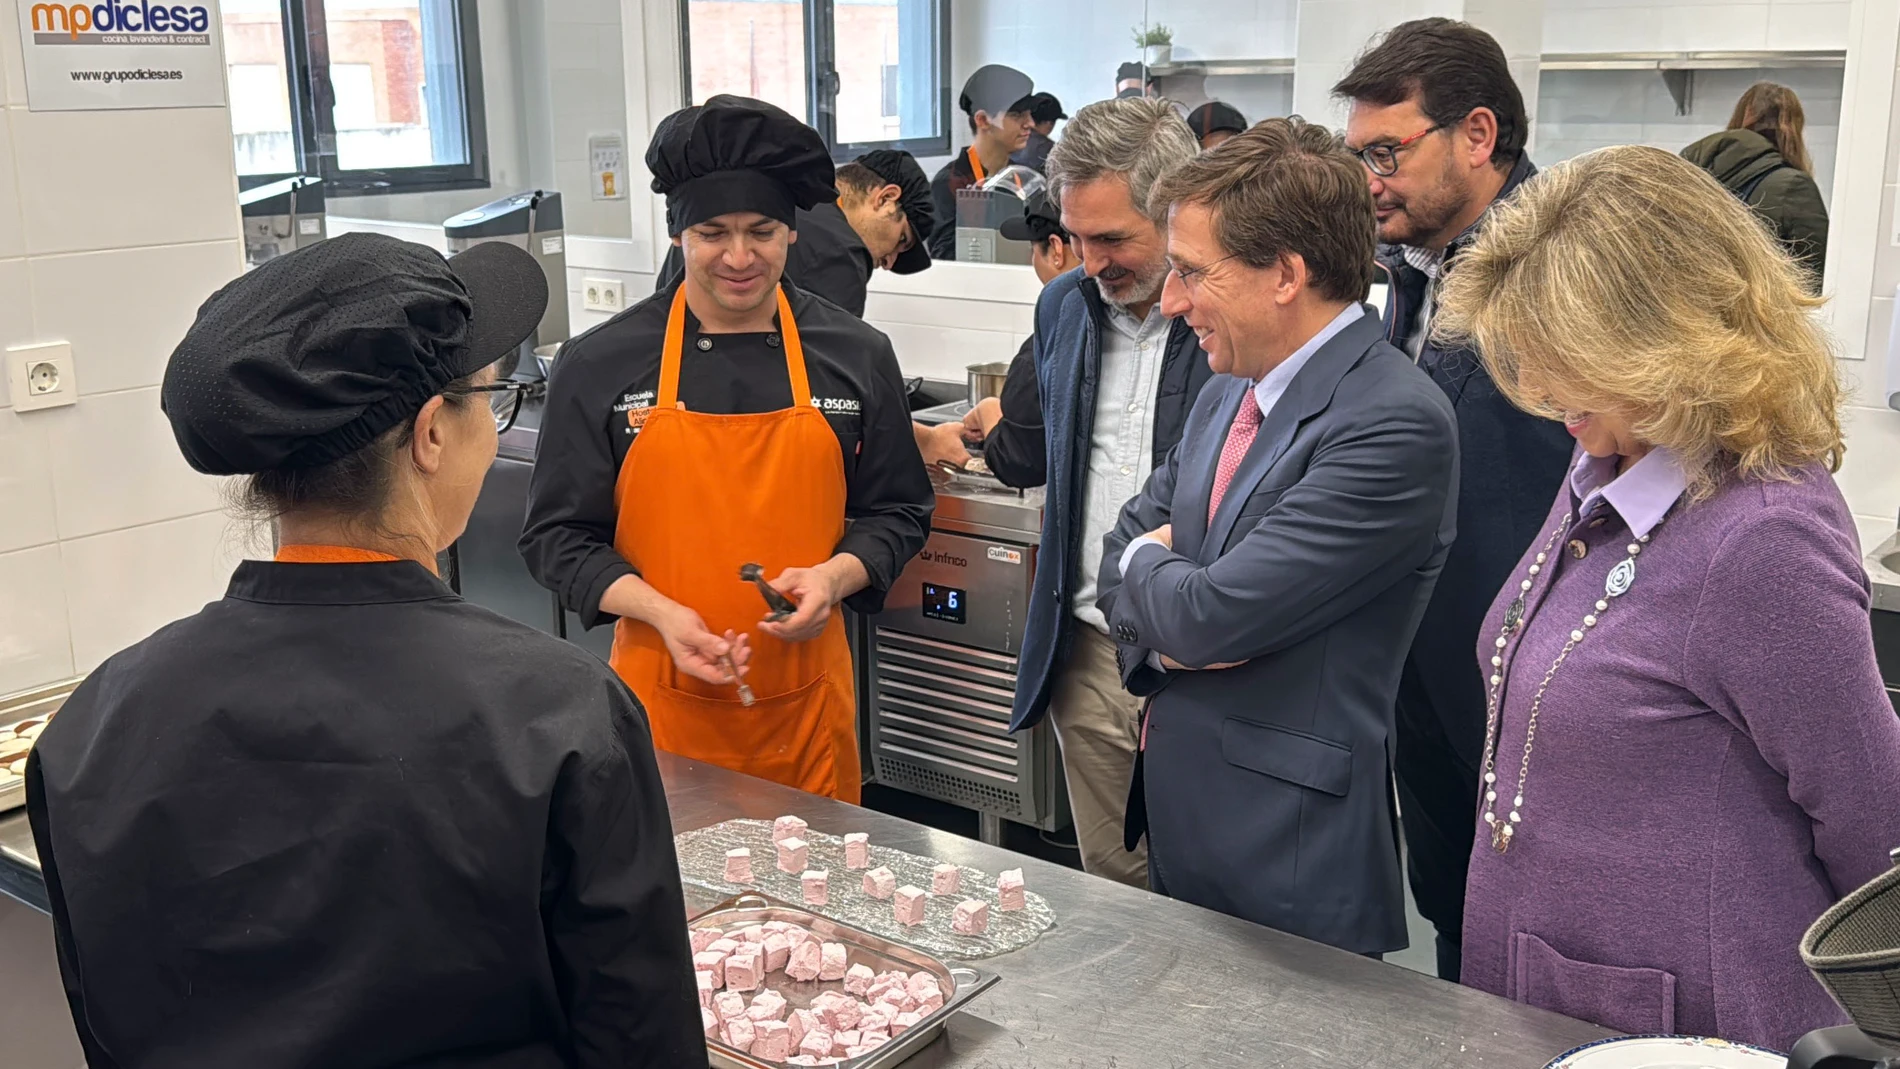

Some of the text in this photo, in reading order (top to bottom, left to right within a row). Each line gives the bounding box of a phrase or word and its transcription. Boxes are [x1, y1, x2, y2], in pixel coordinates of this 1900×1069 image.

[31, 0, 208, 41] mpdiclesa
[169, 35, 175, 43] &
[176, 35, 206, 43] contract
[70, 69, 183, 83] www.grupodiclesa.es
[624, 391, 654, 402] Escuela
[823, 398, 861, 410] aspasi
[948, 591, 958, 608] 6
